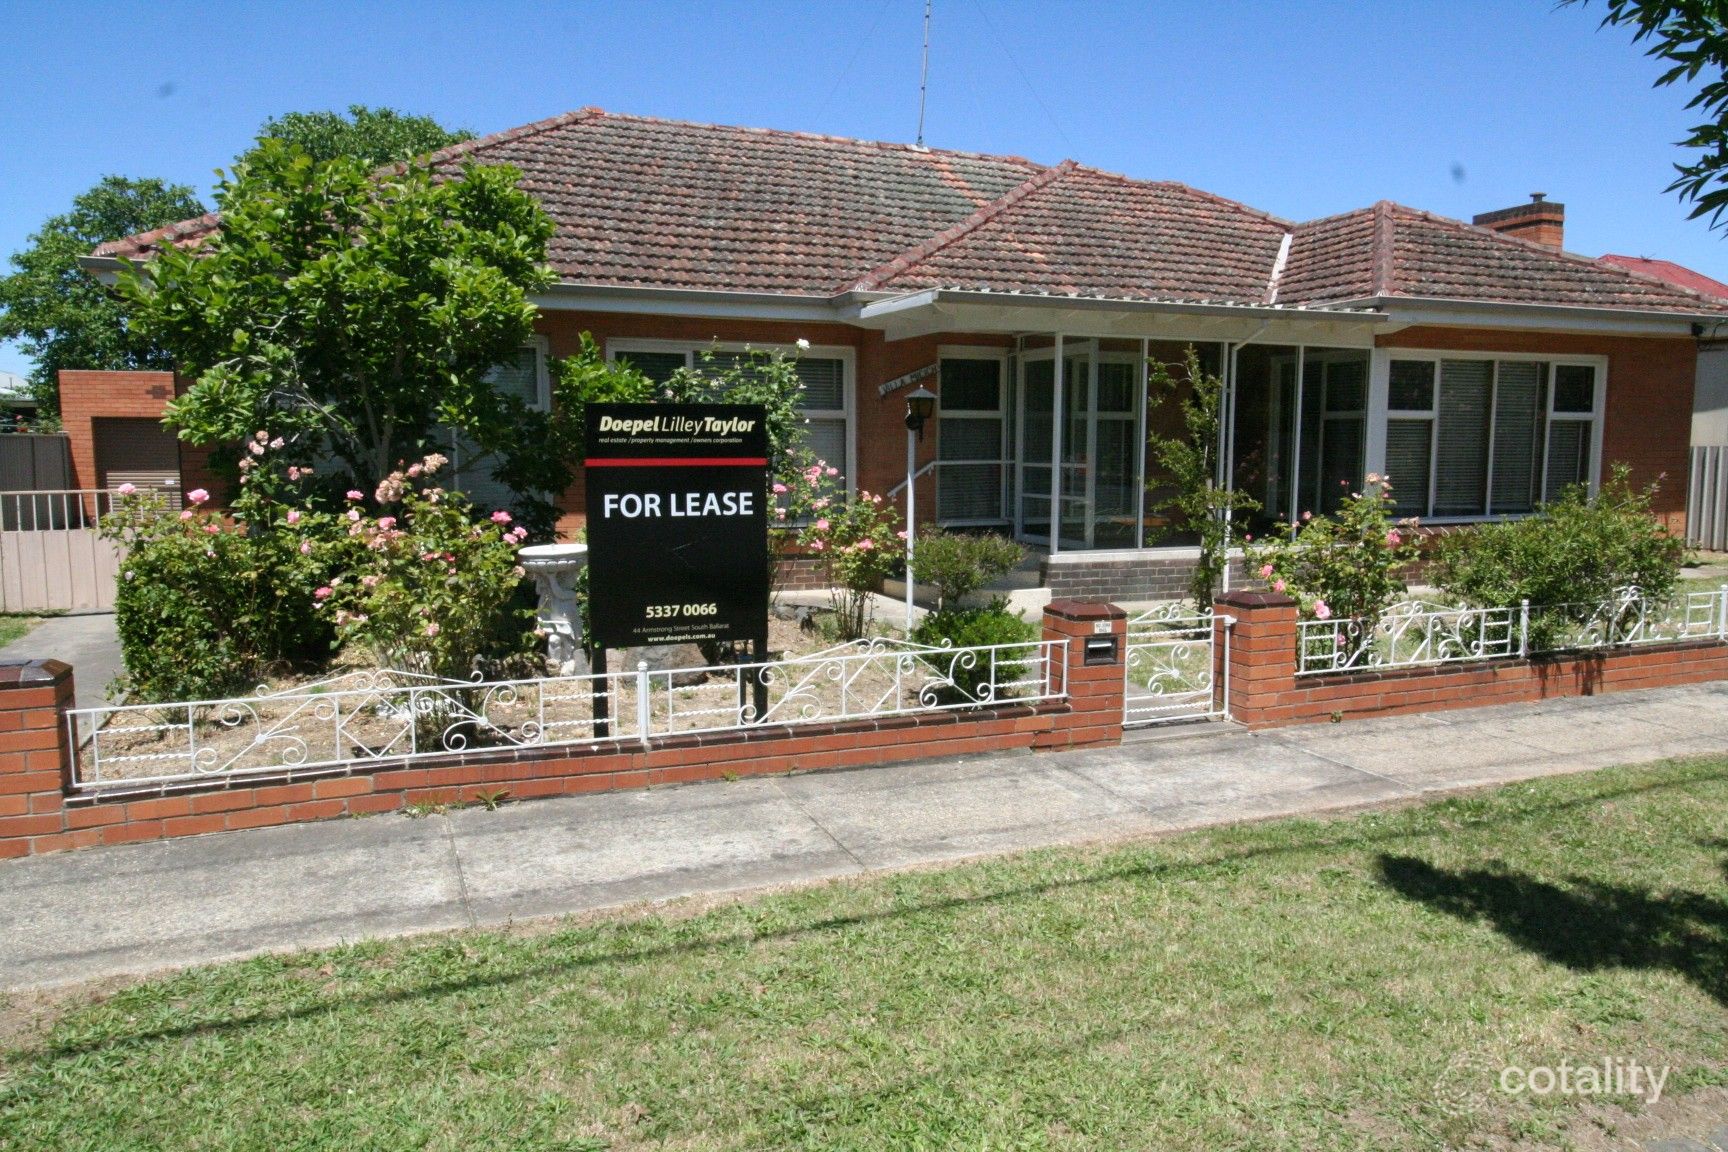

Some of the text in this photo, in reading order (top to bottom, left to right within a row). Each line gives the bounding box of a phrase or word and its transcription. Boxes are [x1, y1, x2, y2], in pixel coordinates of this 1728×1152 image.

[599, 416, 755, 436] Doepel Lilley Taylor
[604, 492, 753, 518] FOR LEASE
[646, 603, 717, 618] 5337 0066
[648, 634, 716, 642] www.doepels.com.au
